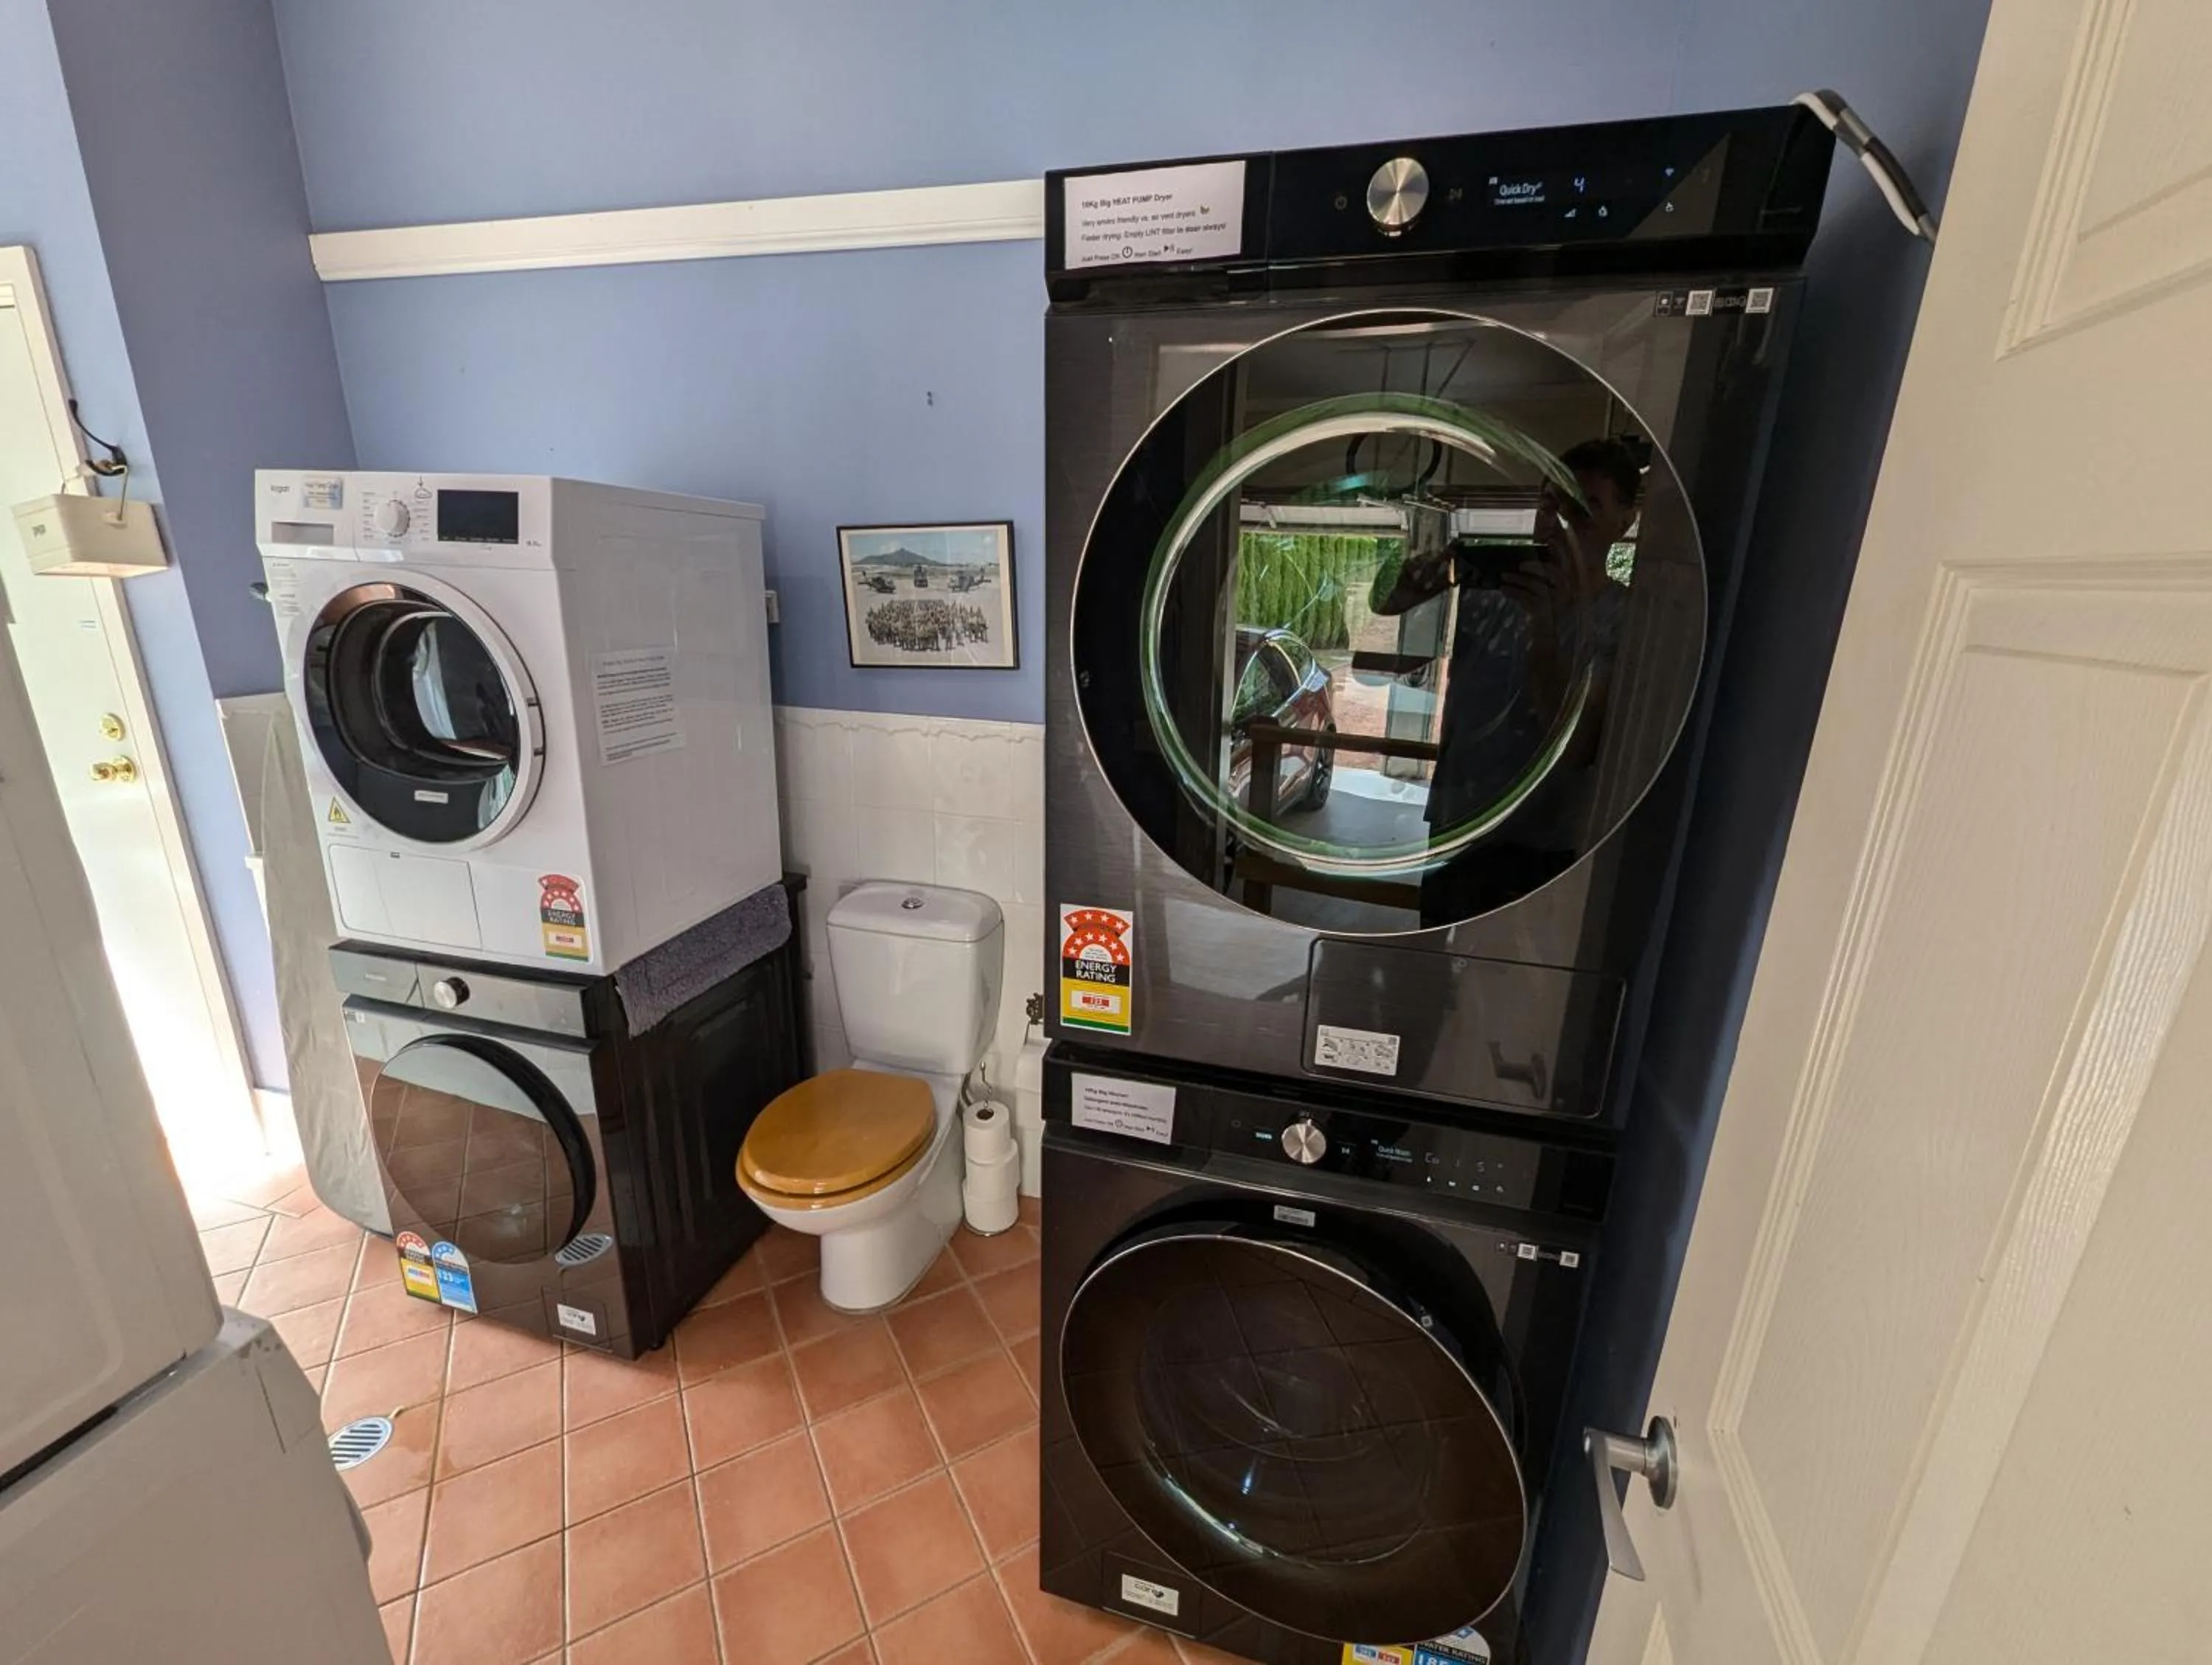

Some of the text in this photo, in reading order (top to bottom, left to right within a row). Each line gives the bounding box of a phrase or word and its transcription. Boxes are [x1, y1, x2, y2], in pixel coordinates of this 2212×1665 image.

[1500, 184, 1521, 196] Quick
[1574, 177, 1585, 192] 4
[1113, 196, 1131, 206] HEAT
[1133, 195, 1152, 204] PUMP
[1154, 193, 1172, 202] Dryer
[1145, 227, 1161, 237] LINT
[1075, 959, 1117, 973] ENERGY
[1077, 970, 1116, 983] RATING
